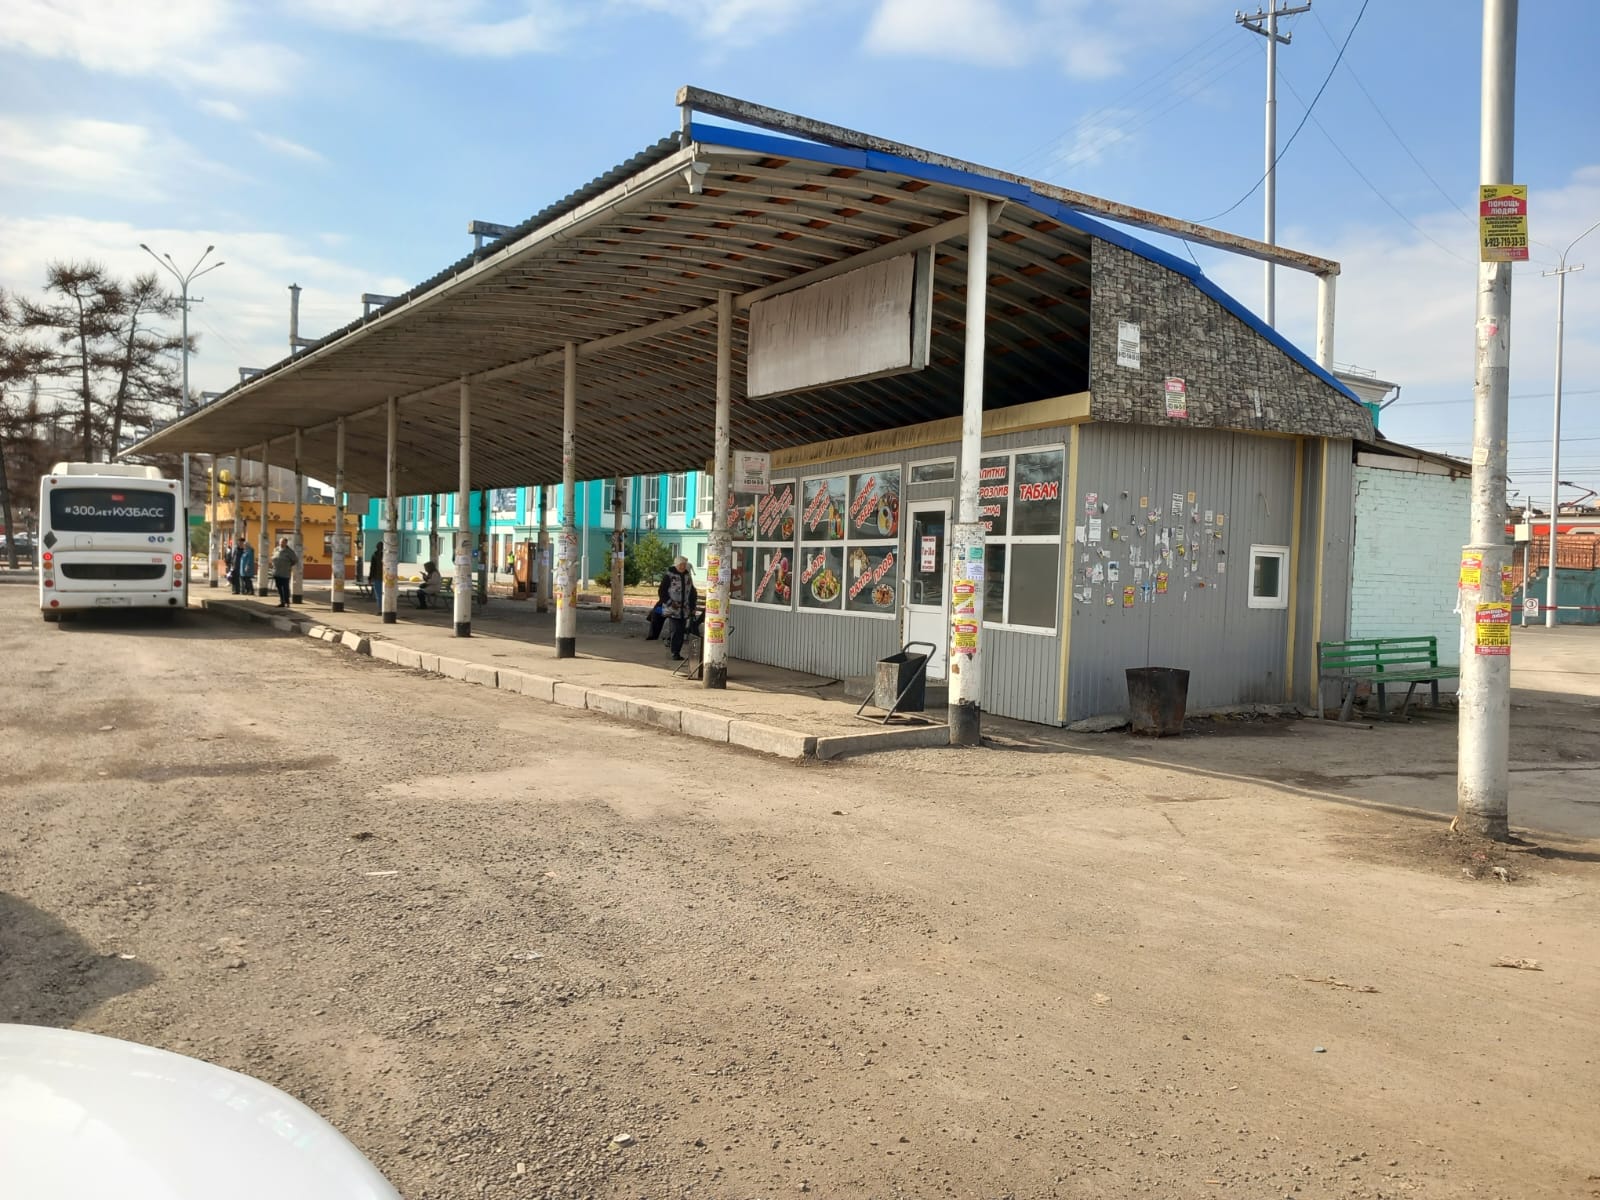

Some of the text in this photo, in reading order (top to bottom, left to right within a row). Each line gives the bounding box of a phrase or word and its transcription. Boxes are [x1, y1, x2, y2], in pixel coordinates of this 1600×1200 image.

[1488, 200, 1519, 208] ПОМОЩЬ
[1490, 207, 1518, 215] ЛЮДЯМ
[850, 475, 876, 519] ГОРЯЧИЕ
[1020, 481, 1059, 501] ТАБАК
[855, 492, 879, 529] ОБЕДЫ
[849, 552, 894, 601] МАНТЫ ПЛОВ
